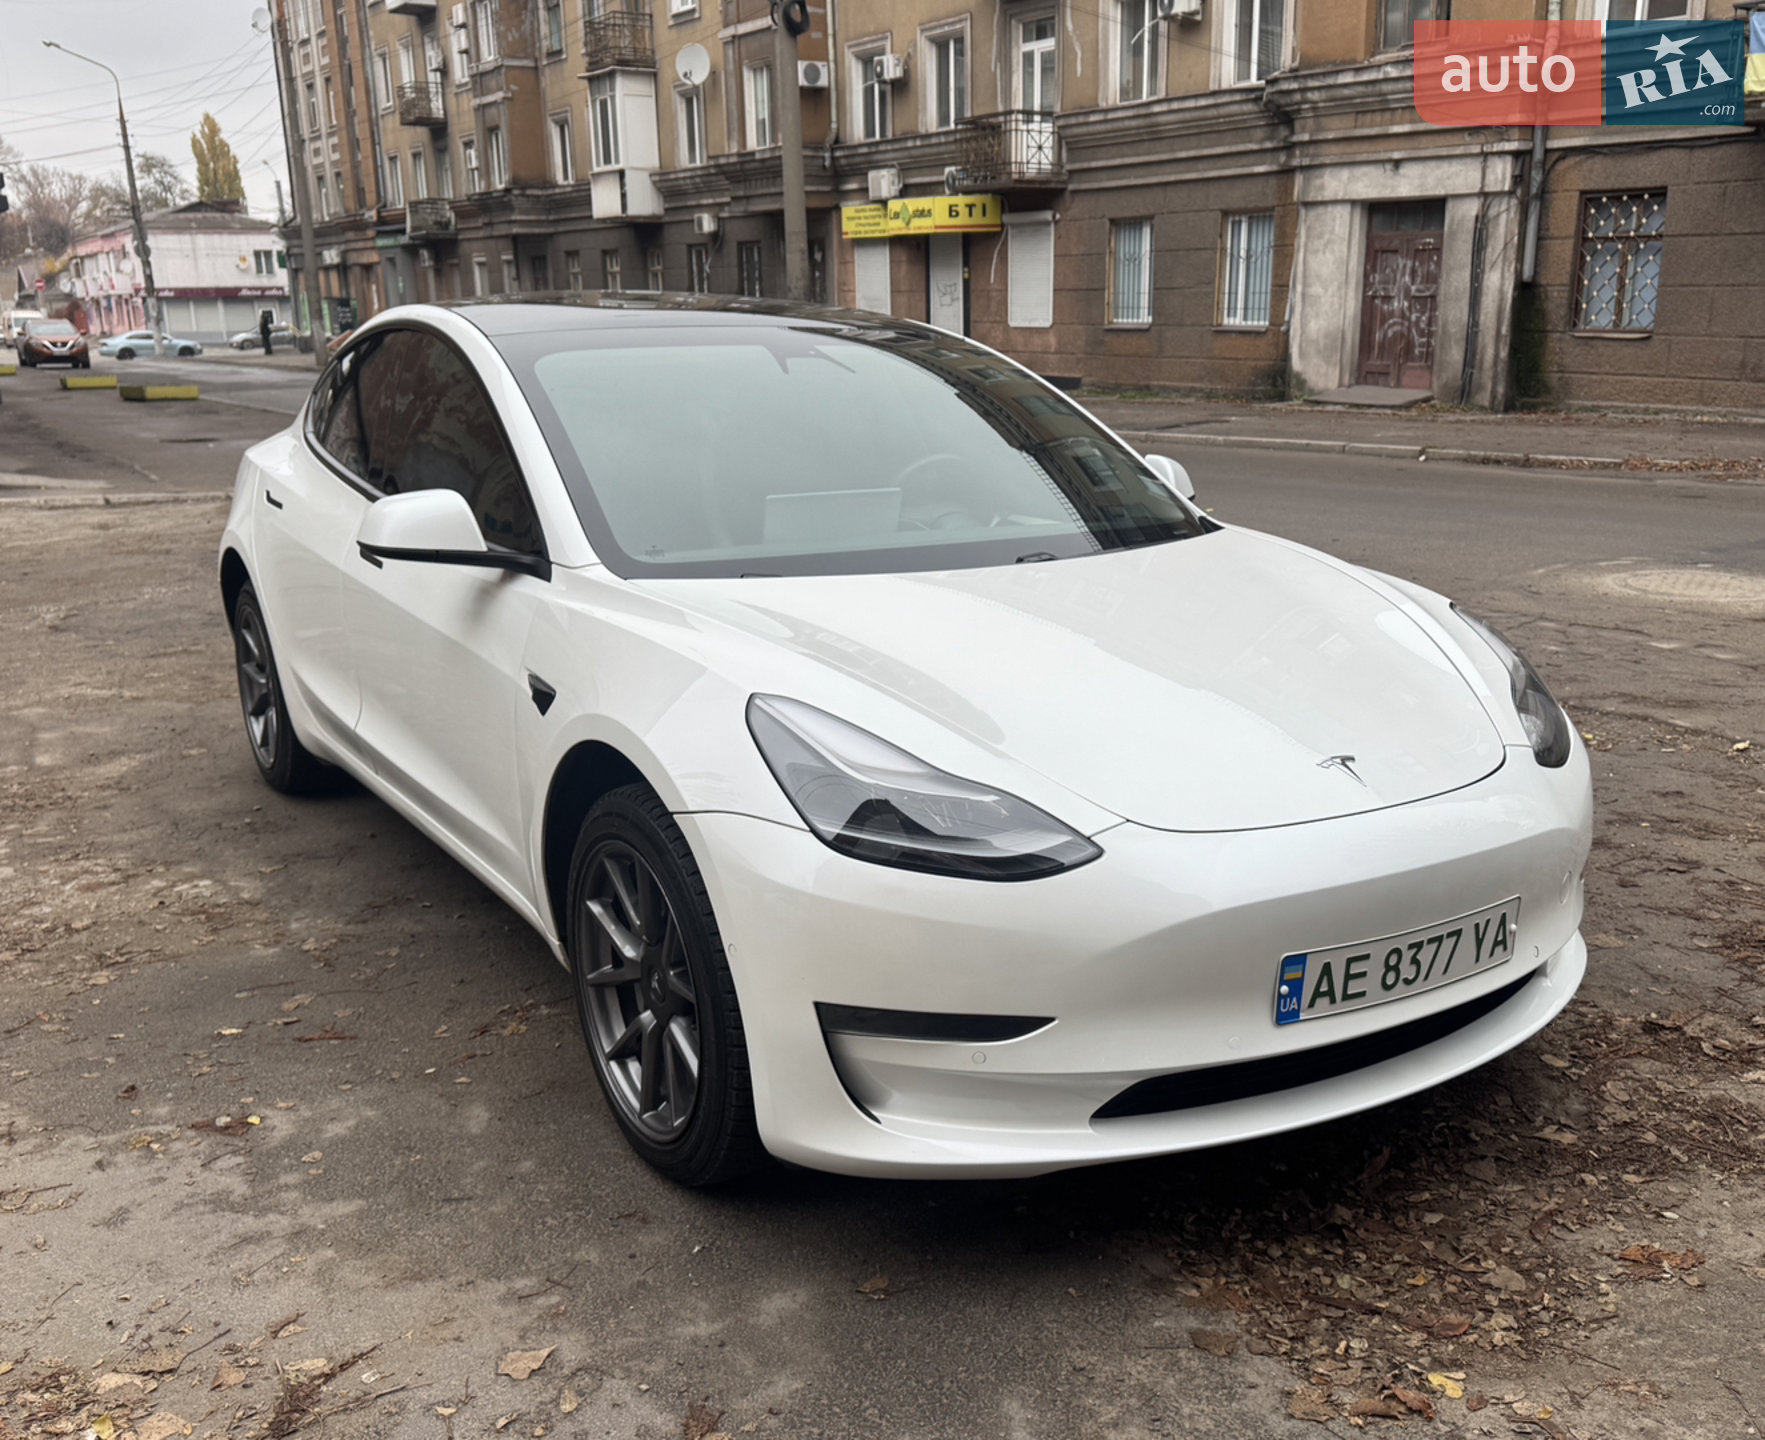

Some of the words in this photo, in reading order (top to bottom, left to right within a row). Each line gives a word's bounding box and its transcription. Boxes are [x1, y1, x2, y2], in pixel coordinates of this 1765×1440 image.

[948, 203, 987, 218] БТІ
[1307, 953, 1371, 1008] AE
[1381, 927, 1463, 991] 8377
[1473, 912, 1509, 964] YA
[1280, 996, 1299, 1013] UA
